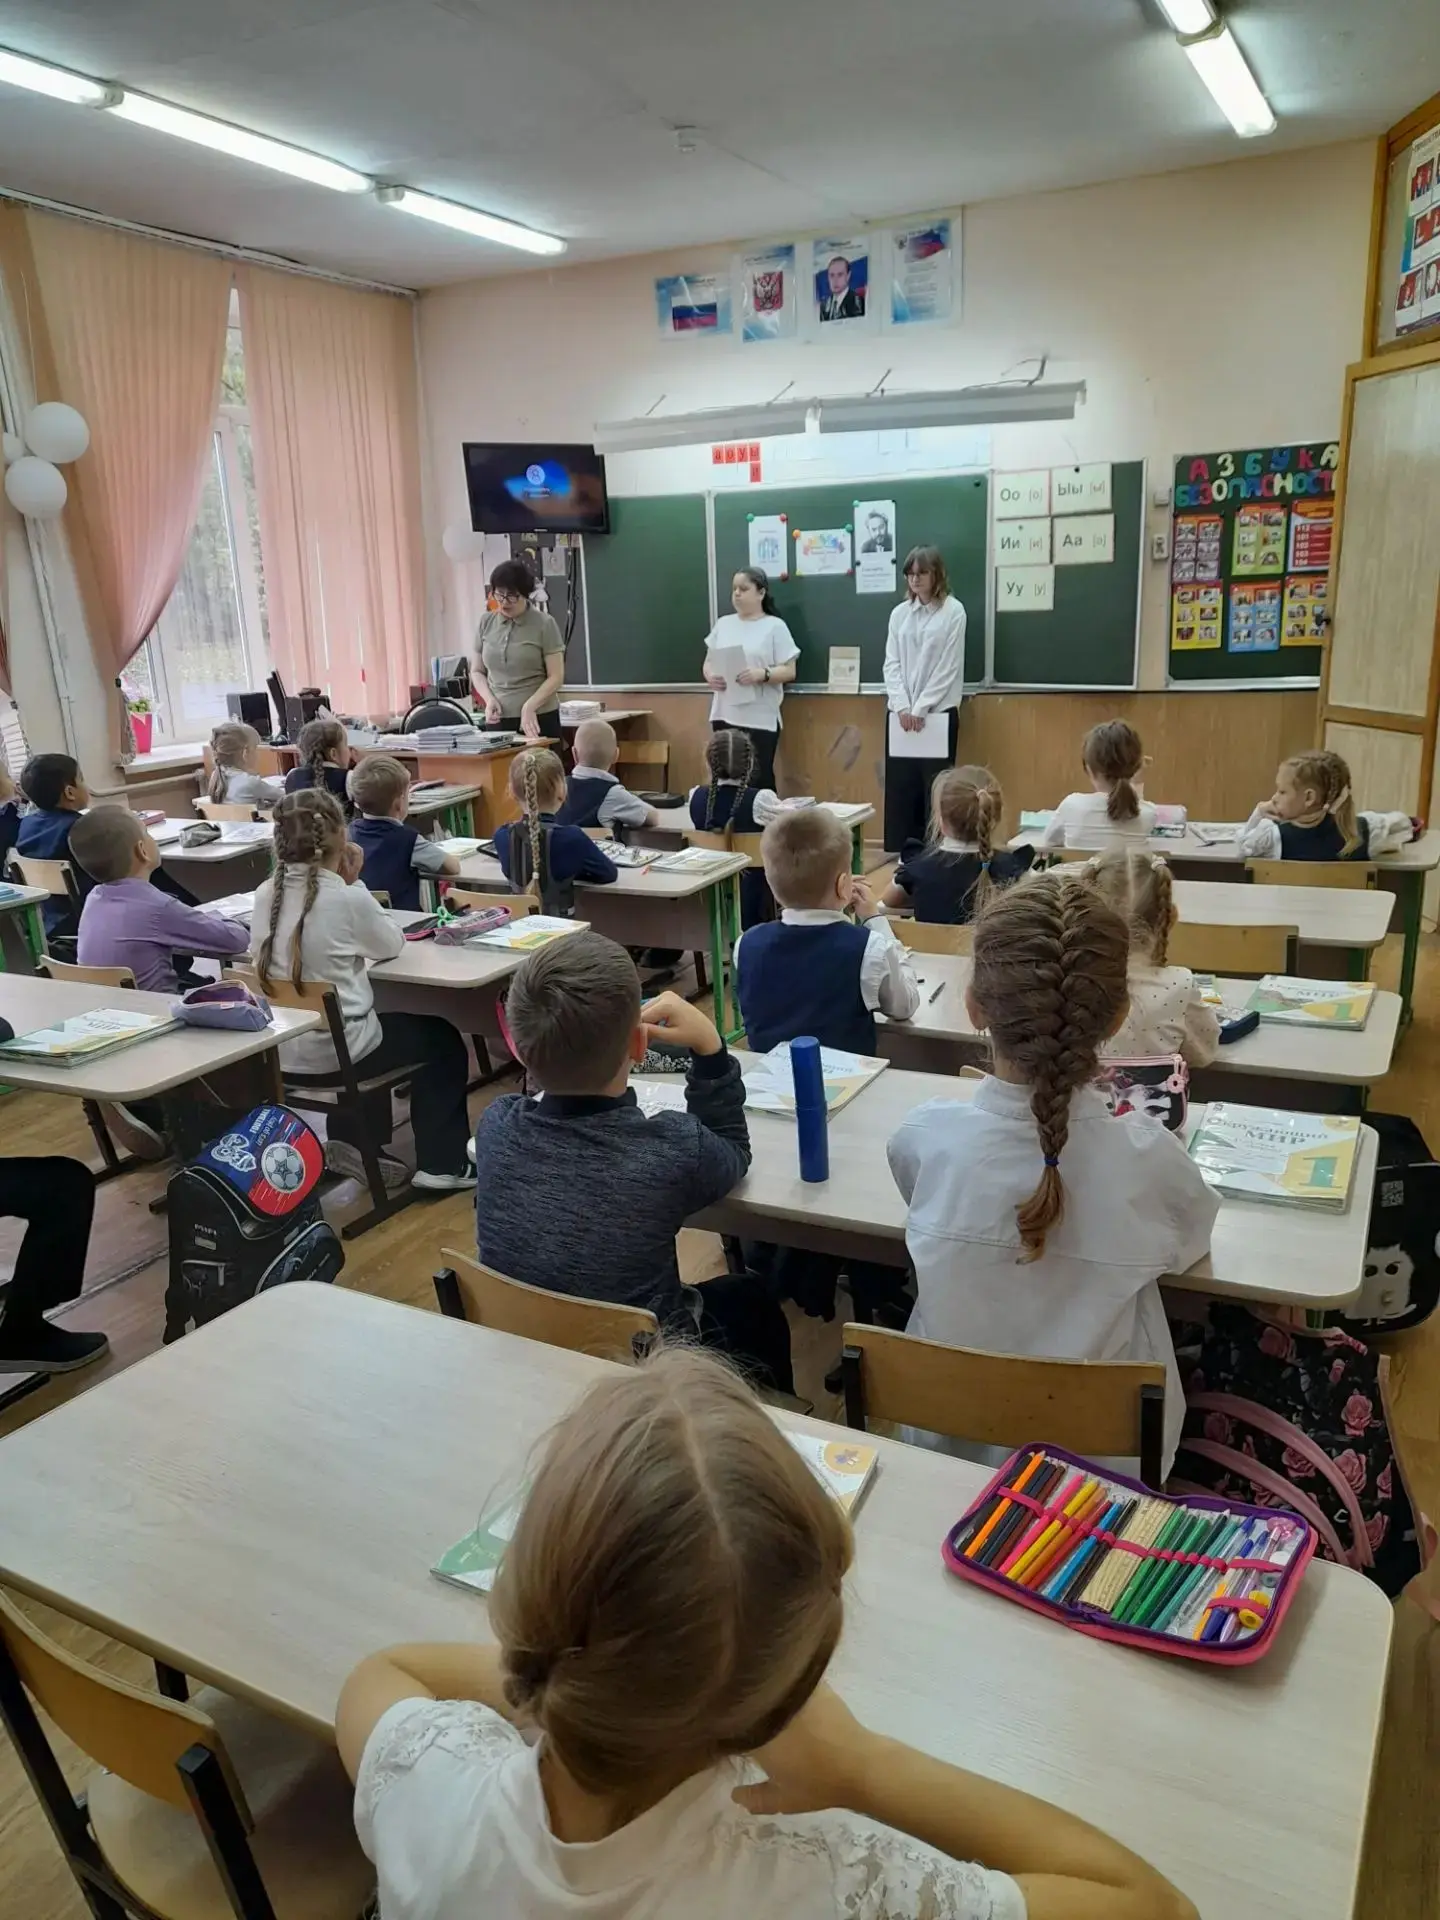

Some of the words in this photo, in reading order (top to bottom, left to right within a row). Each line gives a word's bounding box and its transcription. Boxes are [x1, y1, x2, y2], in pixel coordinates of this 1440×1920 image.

[1000, 488, 1021, 501] Оо
[1058, 483, 1084, 496] Ыы
[1000, 537, 1020, 550] Ии
[1062, 534, 1083, 547] Аа
[1006, 581, 1024, 597] Уу
[249, 1108, 270, 1134] FOOTBALL
